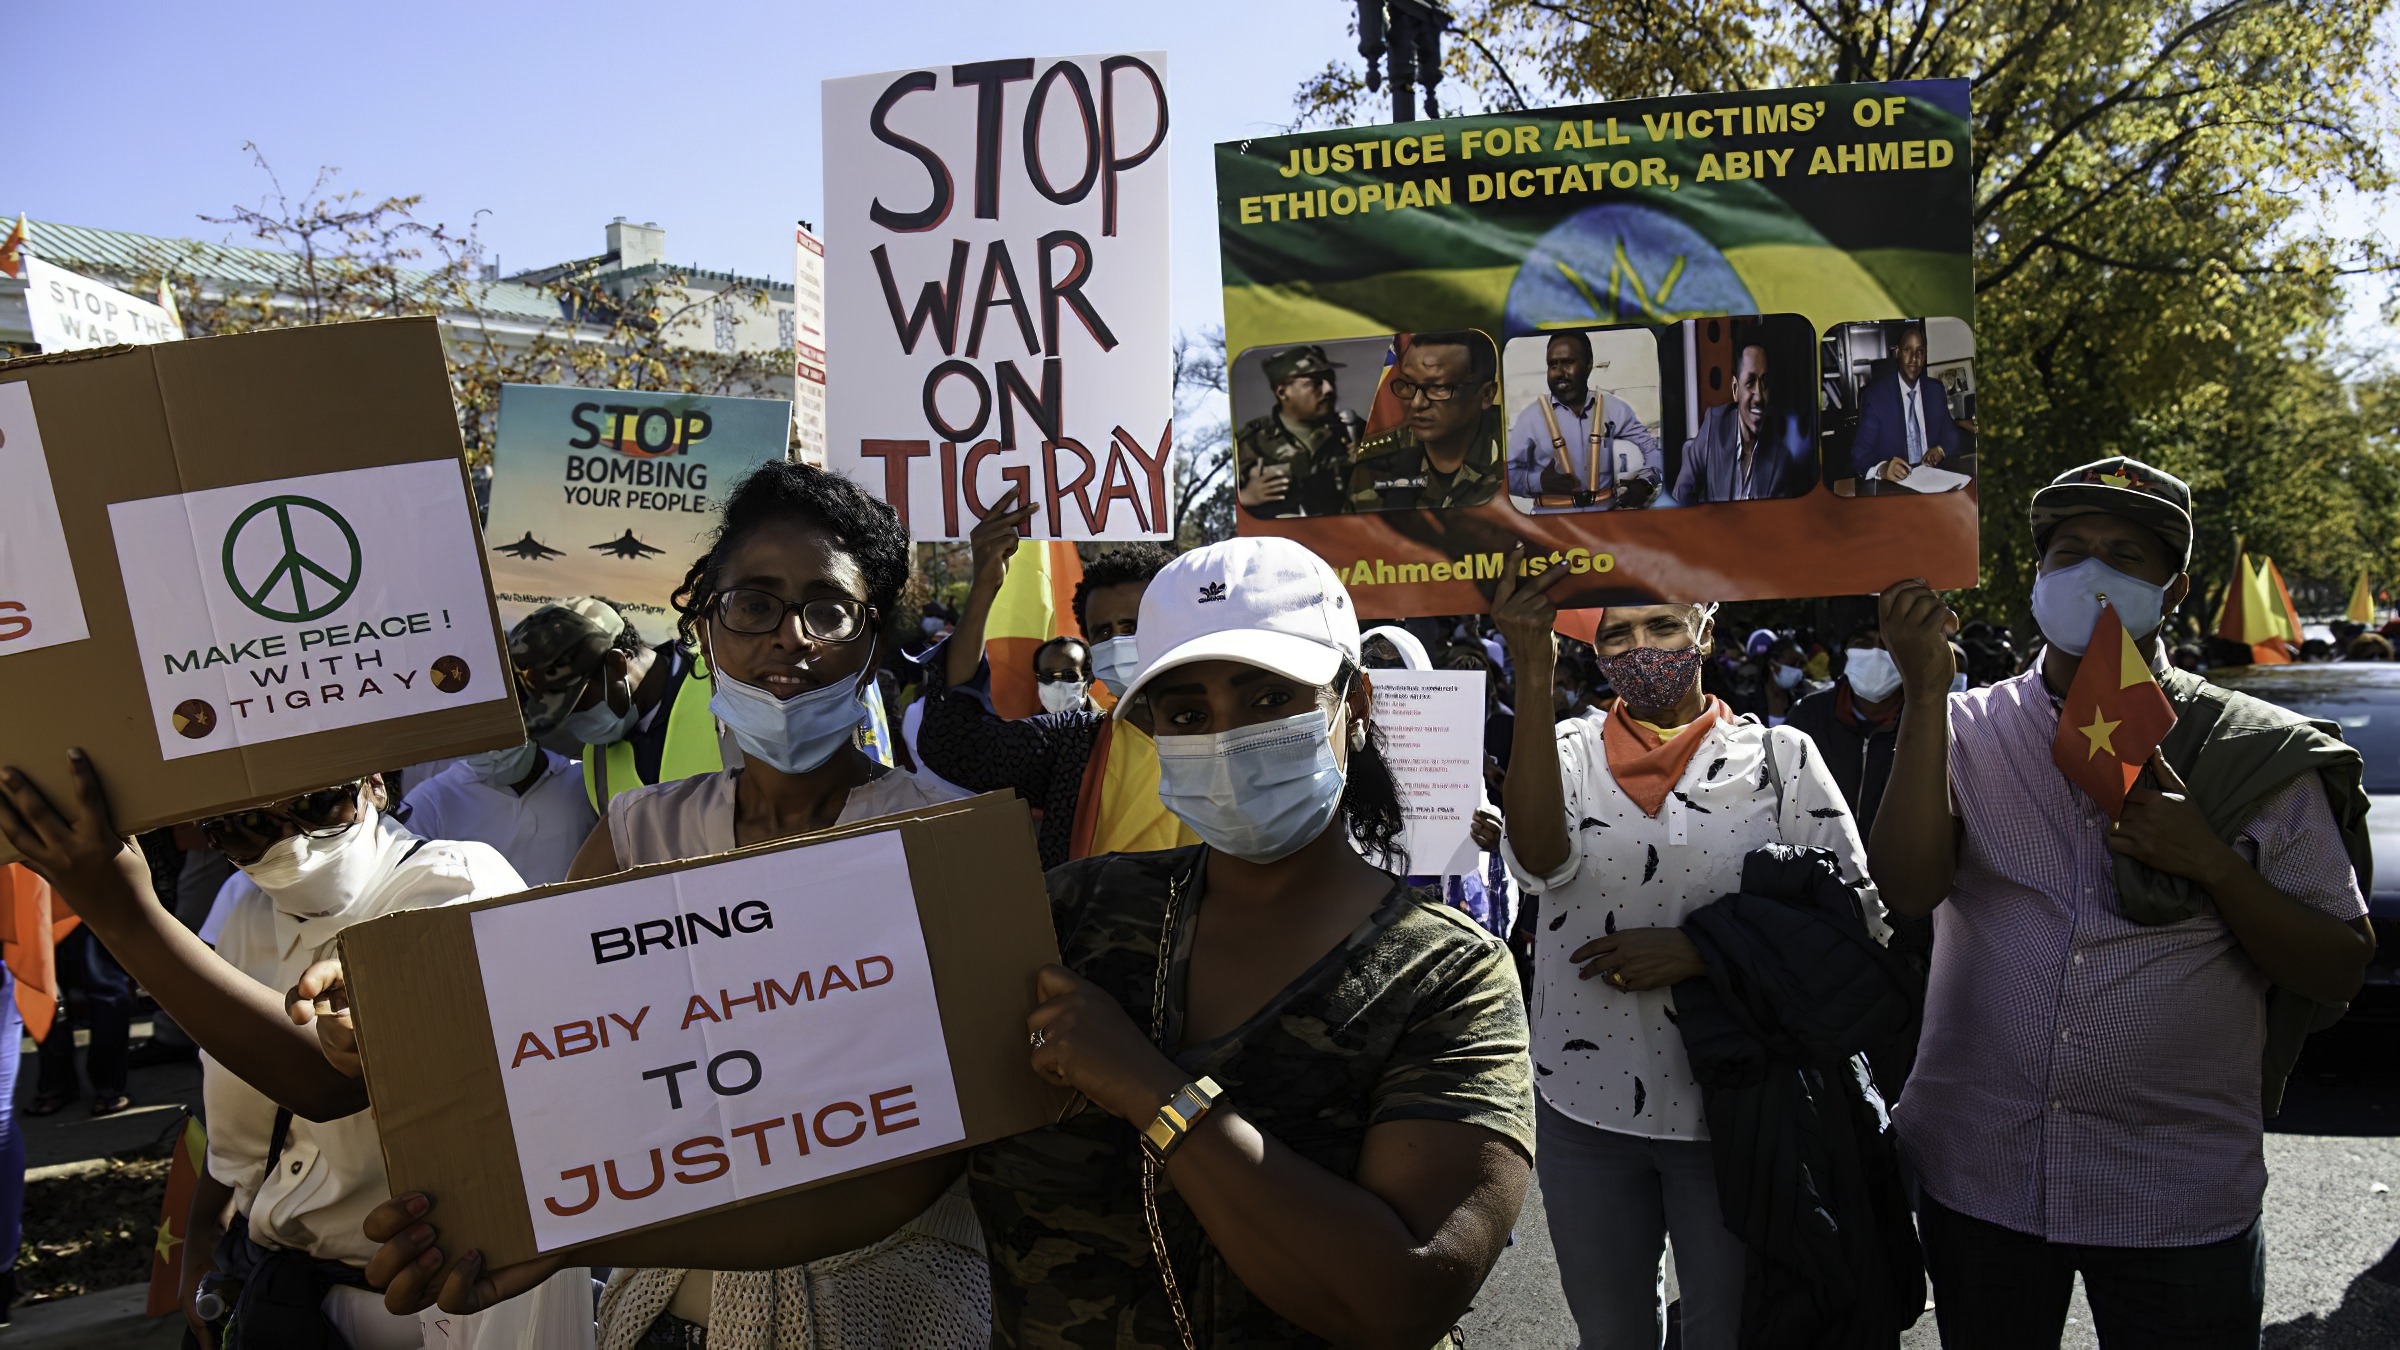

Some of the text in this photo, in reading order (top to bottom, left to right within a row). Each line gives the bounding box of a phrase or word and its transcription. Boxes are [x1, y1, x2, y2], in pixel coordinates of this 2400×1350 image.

[870, 55, 1169, 237] STOP
[1280, 134, 1446, 178] JUSTICE
[1461, 125, 1541, 159] FOR
[1554, 117, 1630, 150] ALL
[1853, 96, 1906, 128] OF
[1239, 139, 1954, 224] ETHIOPIAN DICTATOR, ABIY AHMED
[50, 280, 171, 341] STOP THE
[870, 230, 1119, 358] WAR
[569, 402, 713, 455] STOP
[922, 357, 1063, 450] ON
[564, 486, 706, 513] YOUR PEOPLE
[566, 456, 708, 490] BOMBING
[861, 418, 1172, 538] TIGRAY
[163, 635, 287, 674] MAKE
[250, 650, 383, 688] WITH
[230, 670, 417, 718] TIGRAY
[590, 899, 774, 964] BRING
[511, 955, 894, 1069] ABIY AHMAD
[642, 1049, 763, 1109] TO
[544, 1085, 921, 1217] JUSTICE
